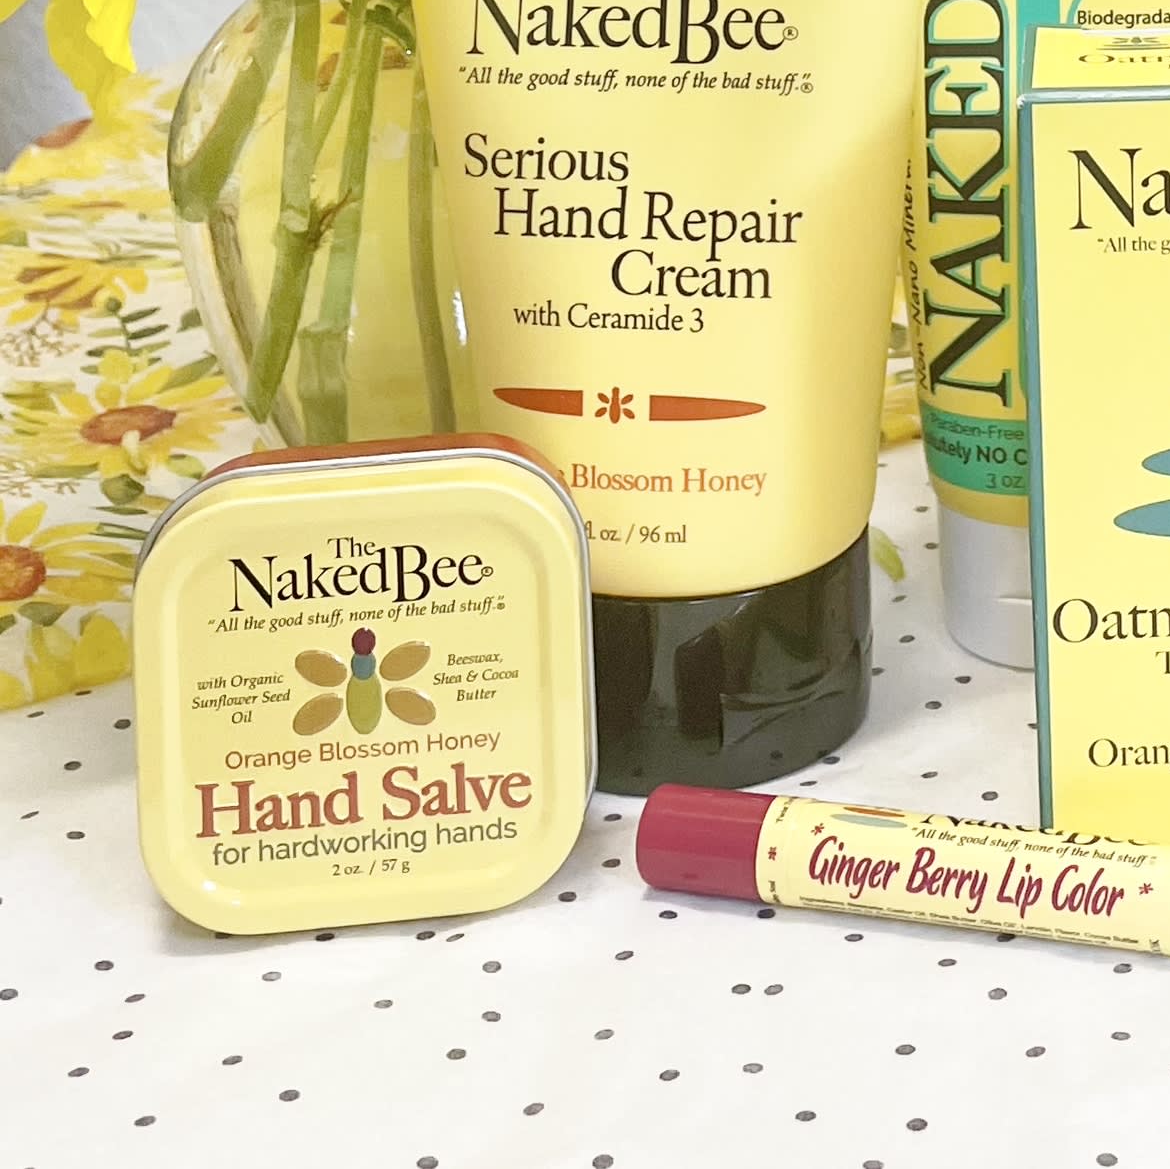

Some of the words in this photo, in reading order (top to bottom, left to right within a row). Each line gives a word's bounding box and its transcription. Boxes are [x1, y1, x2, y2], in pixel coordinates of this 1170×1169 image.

[499, 69, 522, 85] the
[527, 69, 568, 91] good
[626, 74, 666, 88] none
[671, 70, 691, 94] of
[693, 72, 717, 89] the
[722, 72, 750, 90] bad
[464, 133, 630, 182] Serious
[494, 185, 628, 241] Hand
[641, 190, 803, 262] Repair
[1132, 237, 1156, 252] the
[610, 249, 771, 299] Cream
[513, 301, 561, 328] with
[568, 304, 683, 332] Ceramide
[689, 308, 704, 332] 3
[976, 445, 1007, 464] NO
[571, 463, 673, 492] Blossom
[681, 468, 767, 497] Honey
[985, 473, 997, 489] 3
[625, 524, 635, 545] /
[639, 525, 660, 543] 96
[665, 524, 687, 543] ml
[328, 537, 376, 560] The
[244, 616, 265, 630] the
[269, 612, 303, 632] good
[349, 610, 383, 622] none
[387, 605, 402, 621] of
[406, 604, 427, 617] the
[430, 600, 455, 615] bad
[447, 653, 504, 666] Beeswax,
[197, 676, 226, 690] with
[230, 671, 284, 690] Organic
[433, 672, 462, 686] Shea
[466, 670, 478, 682] &
[481, 668, 519, 681] Cocoa
[191, 694, 258, 711] Sunflower
[262, 689, 291, 703] Seed
[456, 688, 496, 701] Butter
[231, 710, 252, 724] Oil
[224, 745, 312, 771] Orange
[319, 738, 419, 762] Blossom
[426, 731, 502, 758] Honey
[195, 770, 364, 839] Hand
[381, 761, 533, 822] Salve
[212, 842, 249, 865] for
[258, 826, 428, 864] hardworking
[435, 817, 518, 845] hands
[938, 831, 957, 841] the
[959, 834, 988, 847] good
[1024, 842, 1053, 854] none
[1056, 845, 1073, 861] of
[1071, 846, 1090, 858] the
[1092, 849, 1114, 862] bad
[332, 864, 341, 876] 2
[369, 860, 376, 876] /
[381, 858, 398, 872] 57
[401, 861, 410, 874] g
[808, 835, 901, 899] Ginger
[905, 846, 989, 914] Berry
[996, 856, 1043, 920] Lip
[1051, 864, 1125, 917] Color
